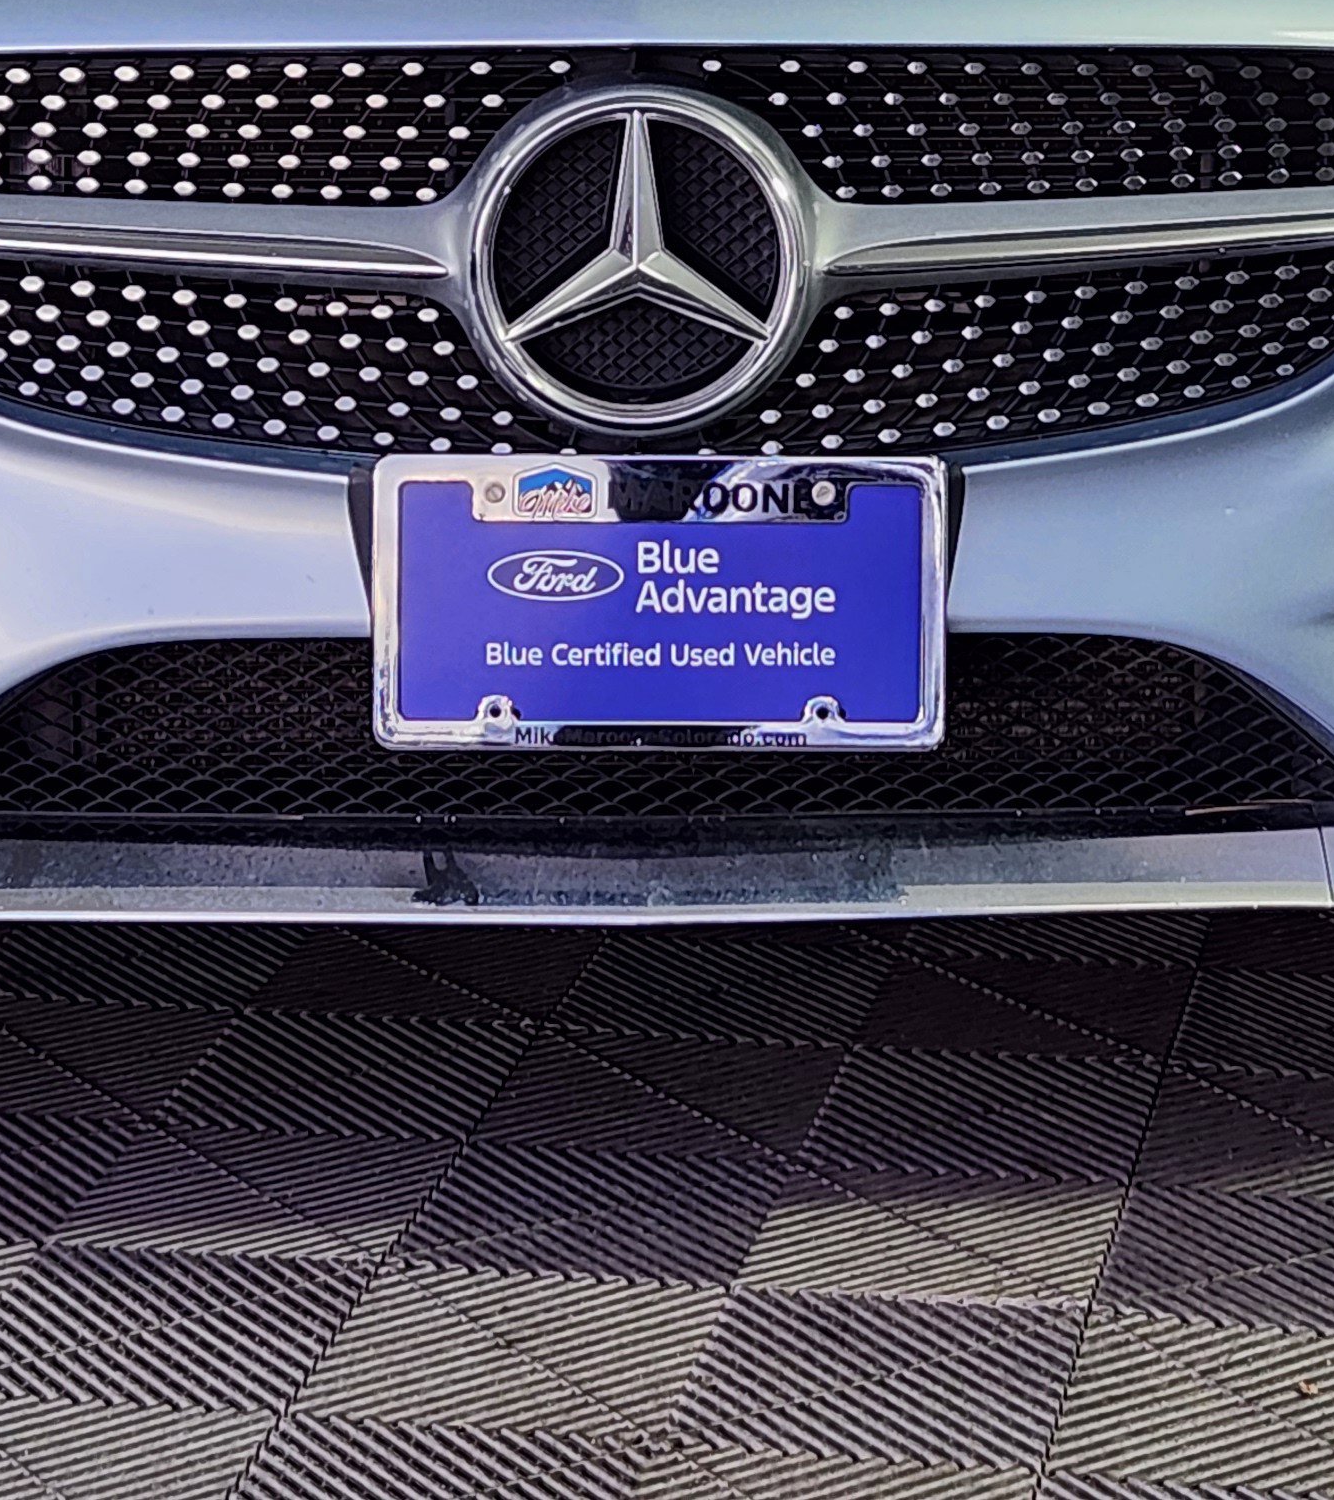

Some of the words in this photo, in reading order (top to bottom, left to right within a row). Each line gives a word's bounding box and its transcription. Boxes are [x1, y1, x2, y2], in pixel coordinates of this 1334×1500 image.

[512, 554, 598, 596] Ford
[637, 541, 720, 575] Blue
[636, 578, 836, 619] Advantage
[485, 642, 543, 666] Blue
[552, 642, 661, 667] Certified
[671, 642, 735, 667] Used
[744, 642, 836, 667] Vehicle
